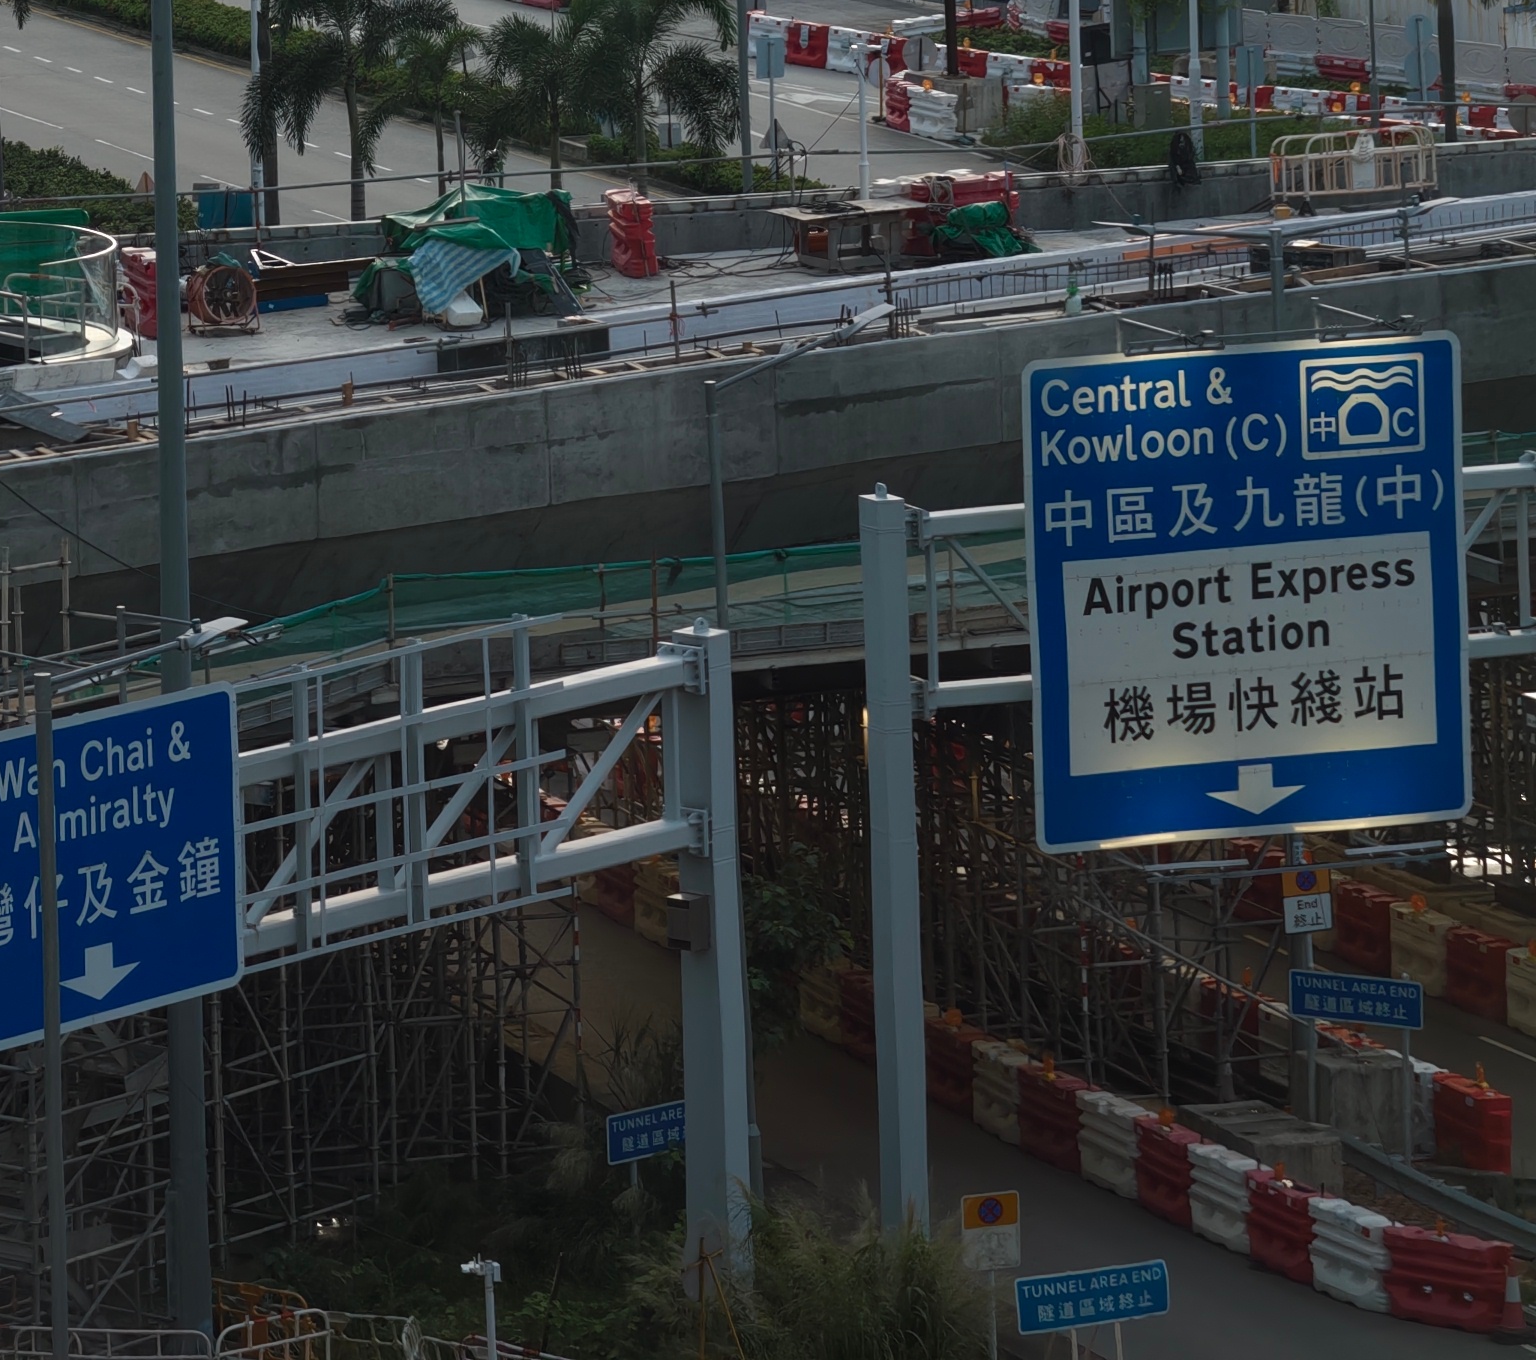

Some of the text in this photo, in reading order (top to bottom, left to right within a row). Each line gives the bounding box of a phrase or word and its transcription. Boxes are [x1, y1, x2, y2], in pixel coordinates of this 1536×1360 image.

[1040, 367, 1233, 418] Central &
[1040, 424, 1214, 467] Kowloon
[1044, 464, 1444, 547] 中區及九龍(中)
[1083, 557, 1416, 619] Airport Express
[1172, 614, 1331, 660] Station
[80, 727, 155, 781] Chai
[167, 721, 192, 763] &
[13, 783, 176, 853] Amiralty
[1297, 897, 1318, 910] End
[1295, 975, 1417, 999] TUNNEL AREA END
[611, 1107, 685, 1133] TUNNEL ARE
[1022, 1267, 1162, 1299] TUNNEL AREA END
